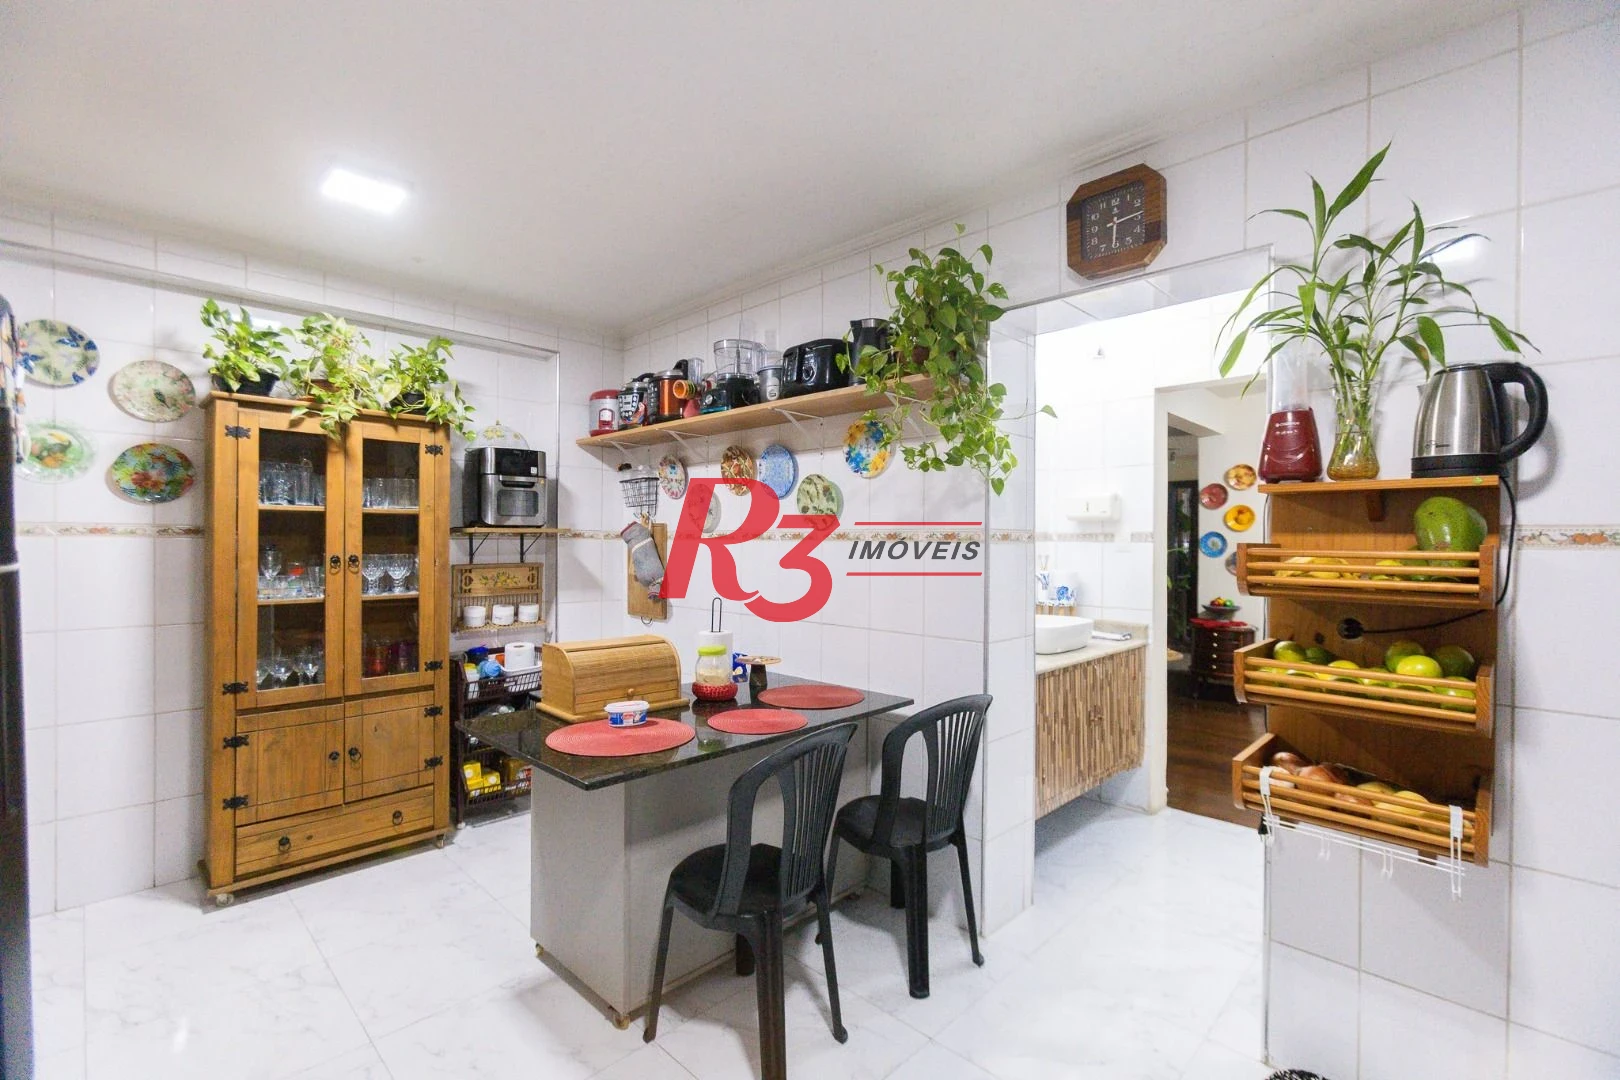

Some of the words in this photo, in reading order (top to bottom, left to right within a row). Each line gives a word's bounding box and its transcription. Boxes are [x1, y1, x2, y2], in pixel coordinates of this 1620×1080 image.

[1100, 201, 1106, 210] 11
[1111, 197, 1120, 206] 12
[1134, 199, 1141, 207] 2
[1091, 212, 1100, 221] 10
[1091, 225, 1098, 233] 9
[1133, 225, 1140, 233] 4
[1091, 237, 1098, 245] 8
[1125, 236, 1132, 245] 5
[1099, 244, 1107, 252] 7
